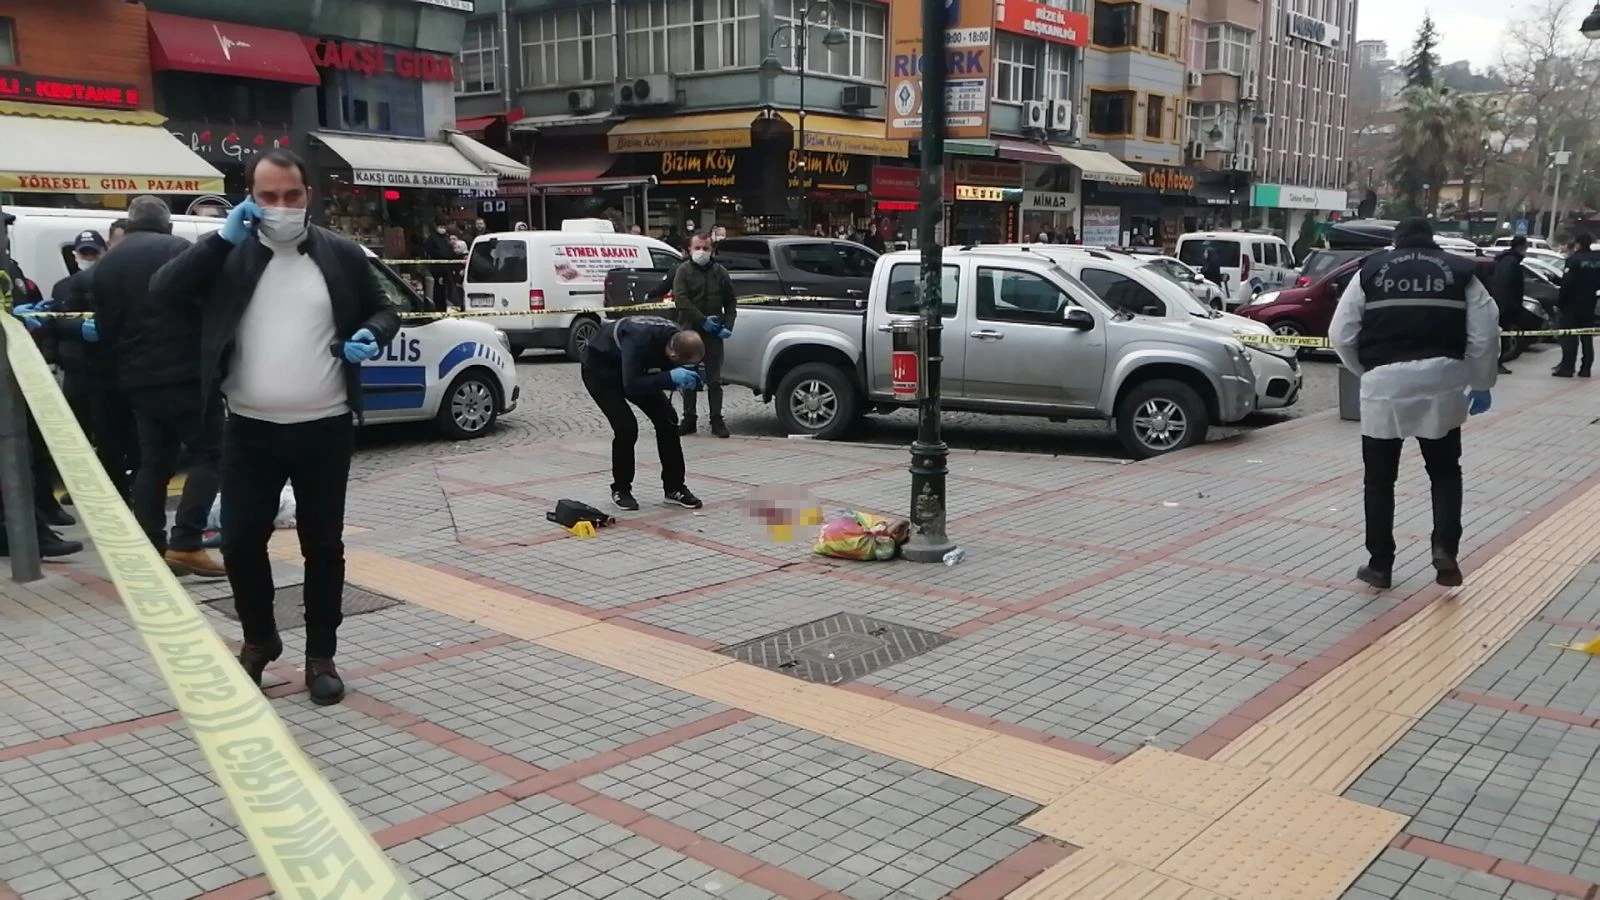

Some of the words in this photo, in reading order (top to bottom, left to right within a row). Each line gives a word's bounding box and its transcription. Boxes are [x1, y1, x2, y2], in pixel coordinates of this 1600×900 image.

[968, 30, 989, 44] 18:00
[396, 51, 455, 82] GIDA
[662, 151, 701, 174] Bizim
[705, 149, 736, 173] Köy
[826, 152, 849, 176] Köy
[18, 175, 90, 190] YÖRESEL
[100, 178, 137, 191] GIDA
[148, 180, 200, 191] PAZARI
[388, 174, 410, 185] GIDA
[413, 176, 419, 184] &
[1167, 168, 1195, 195] Kebap
[1034, 193, 1066, 207] MİMAR
[565, 246, 599, 258] EYMEN
[601, 247, 639, 259] SAKATAT
[1384, 274, 1445, 292] POLİS
